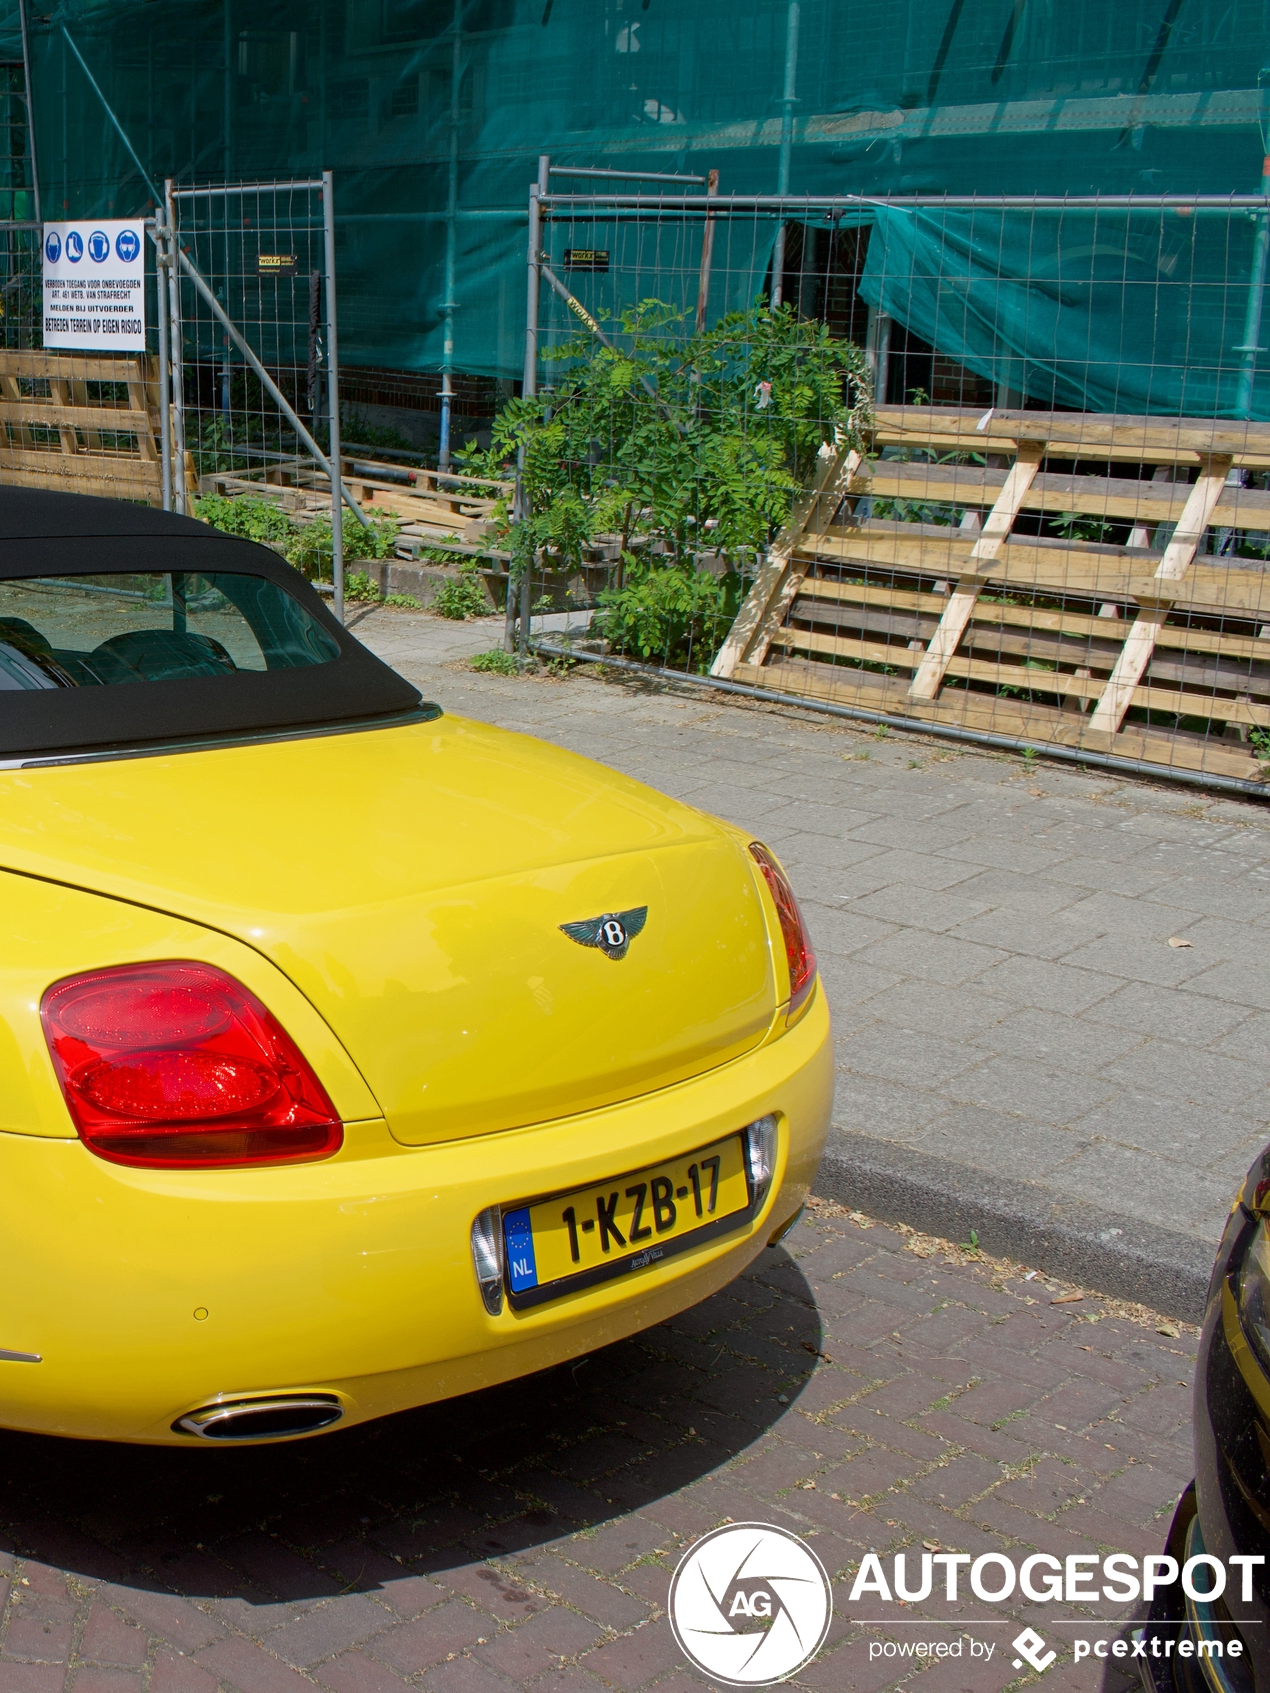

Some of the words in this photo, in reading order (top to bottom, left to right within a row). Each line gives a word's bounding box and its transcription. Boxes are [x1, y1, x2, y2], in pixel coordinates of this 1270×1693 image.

[45, 279, 66, 289] VERBODEN
[66, 279, 87, 289] TOEGANG
[87, 279, 102, 289] VOOR
[102, 279, 141, 289] ONBEVOEGDEN
[52, 290, 61, 299] ART.
[71, 289, 85, 299] WETB.
[86, 290, 97, 299] VAN
[97, 290, 132, 300] STRAFRECHT
[50, 304, 74, 312] MELDEN
[87, 305, 134, 313] UITVOERDER
[45, 318, 70, 333] BETREDEN
[70, 318, 92, 333] TERREIN
[92, 319, 101, 334] OP
[102, 319, 120, 334] EIGEN
[120, 319, 142, 335] RISICO
[562, 1155, 721, 1265] 1-KZB-17
[513, 1257, 533, 1278] NL
